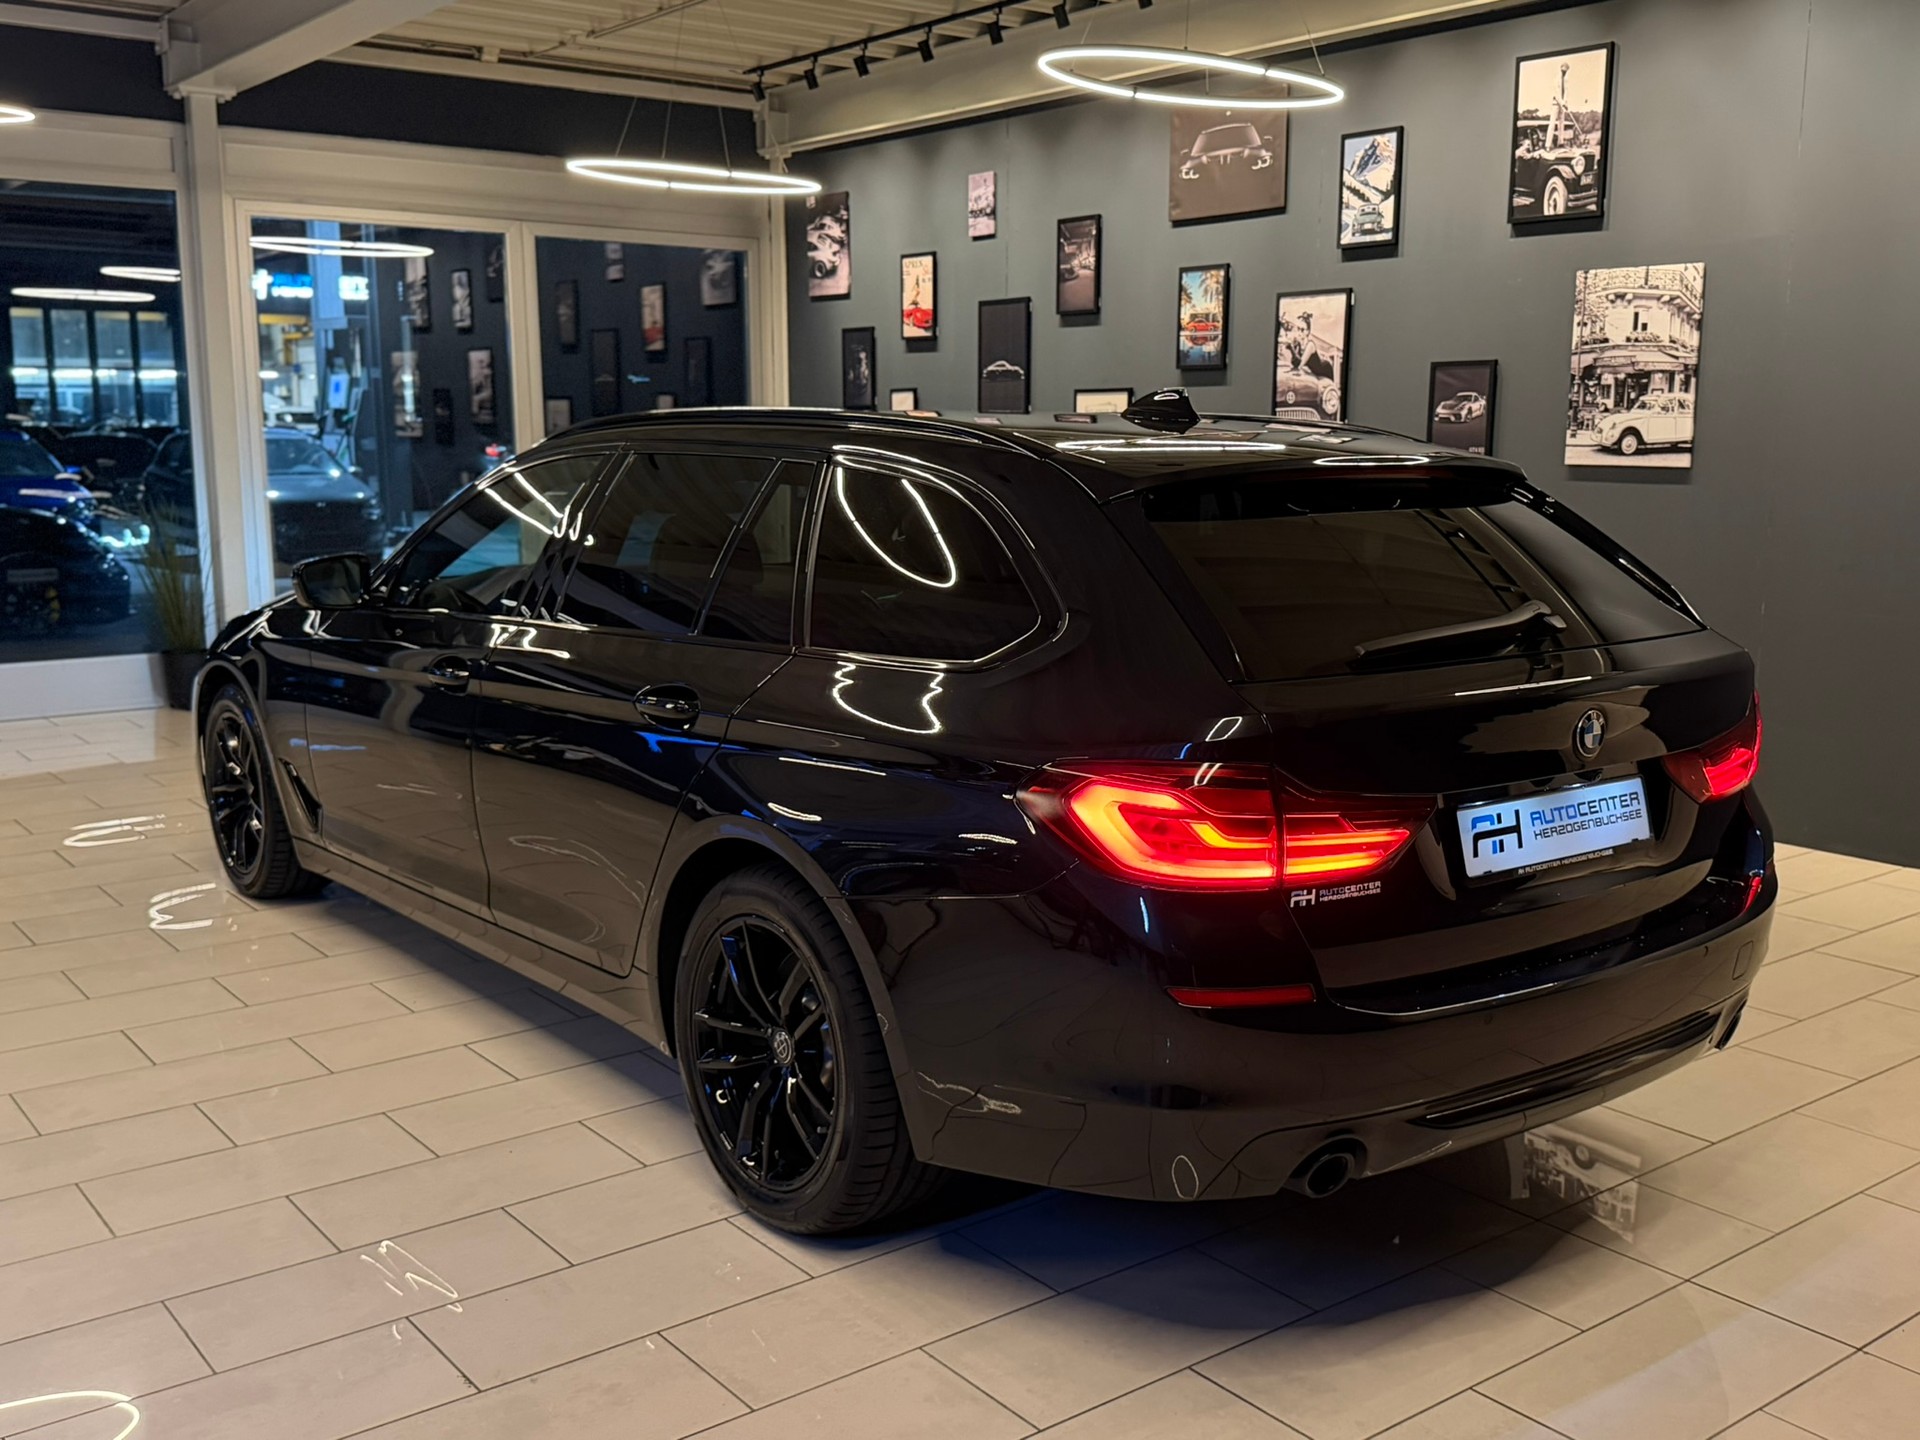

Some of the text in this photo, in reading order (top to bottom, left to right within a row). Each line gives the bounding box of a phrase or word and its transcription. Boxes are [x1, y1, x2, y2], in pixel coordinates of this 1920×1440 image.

[1529, 791, 1641, 827] AUTOCENTER
[1533, 808, 1643, 840] HERZOGENBUCHSEE
[1319, 881, 1382, 897] AUTOCENTER
[1319, 888, 1382, 902] HERZOGENBUCHSEE
